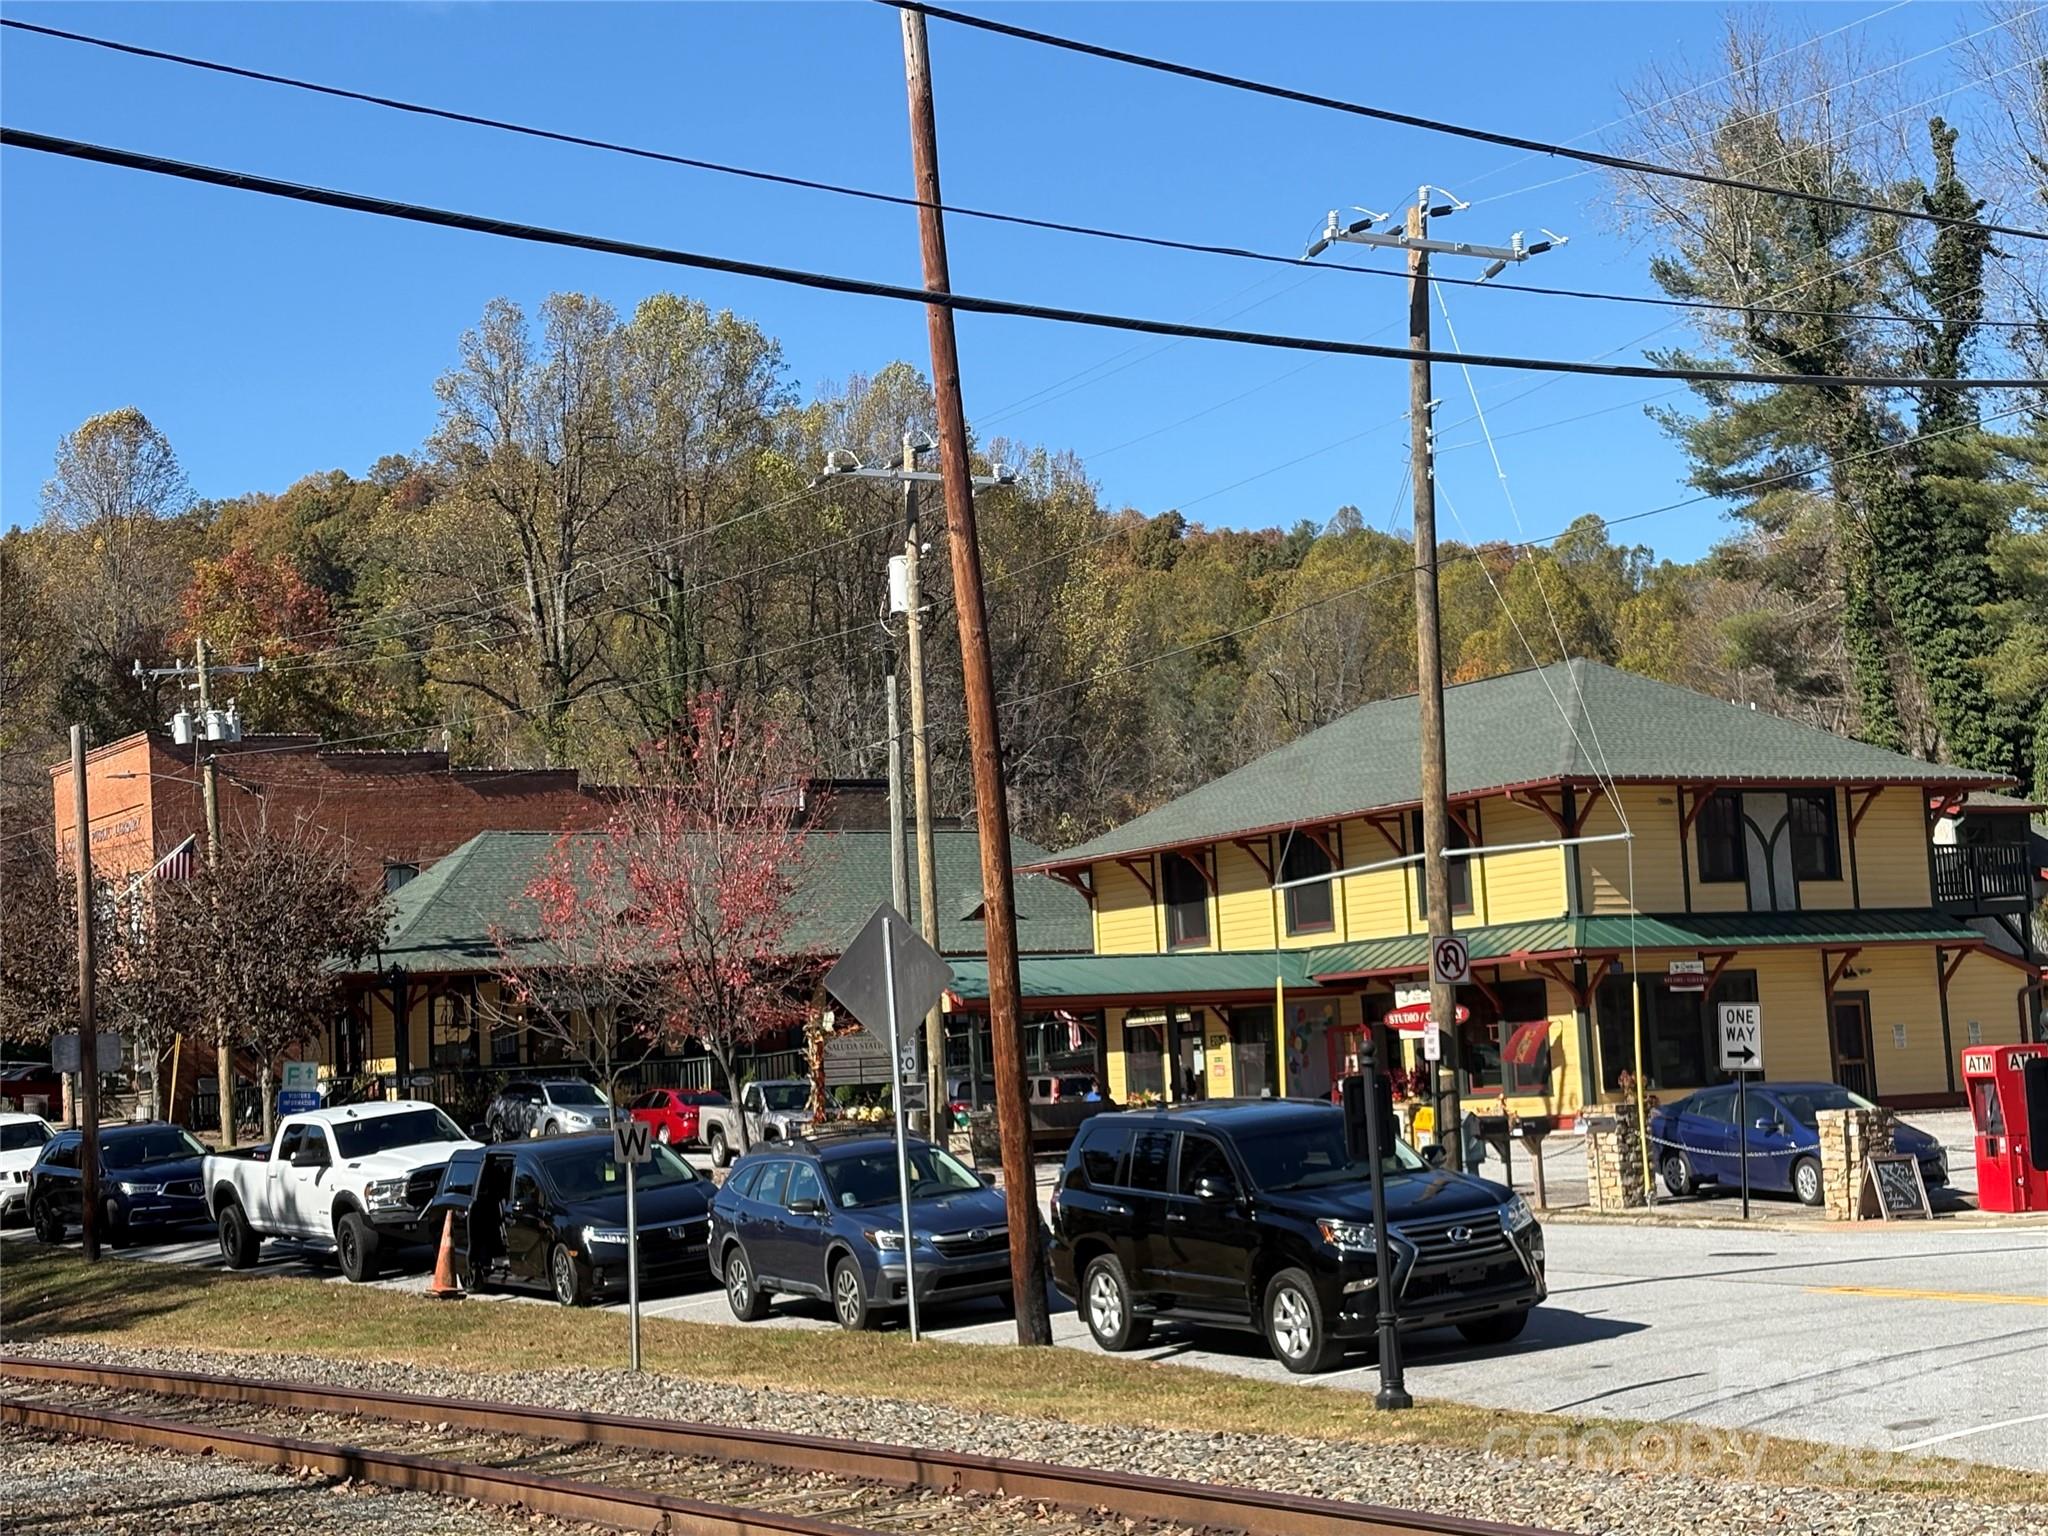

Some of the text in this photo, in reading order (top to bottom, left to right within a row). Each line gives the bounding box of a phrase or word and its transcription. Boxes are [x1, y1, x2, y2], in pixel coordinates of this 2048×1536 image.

[1388, 1012, 1419, 1025] STUDIO
[1726, 1009, 1754, 1024] ONE
[1726, 1027, 1755, 1042] WAY
[826, 1042, 858, 1051] SALUDA
[1968, 1056, 1992, 1072] ATM
[617, 1127, 648, 1156] W
